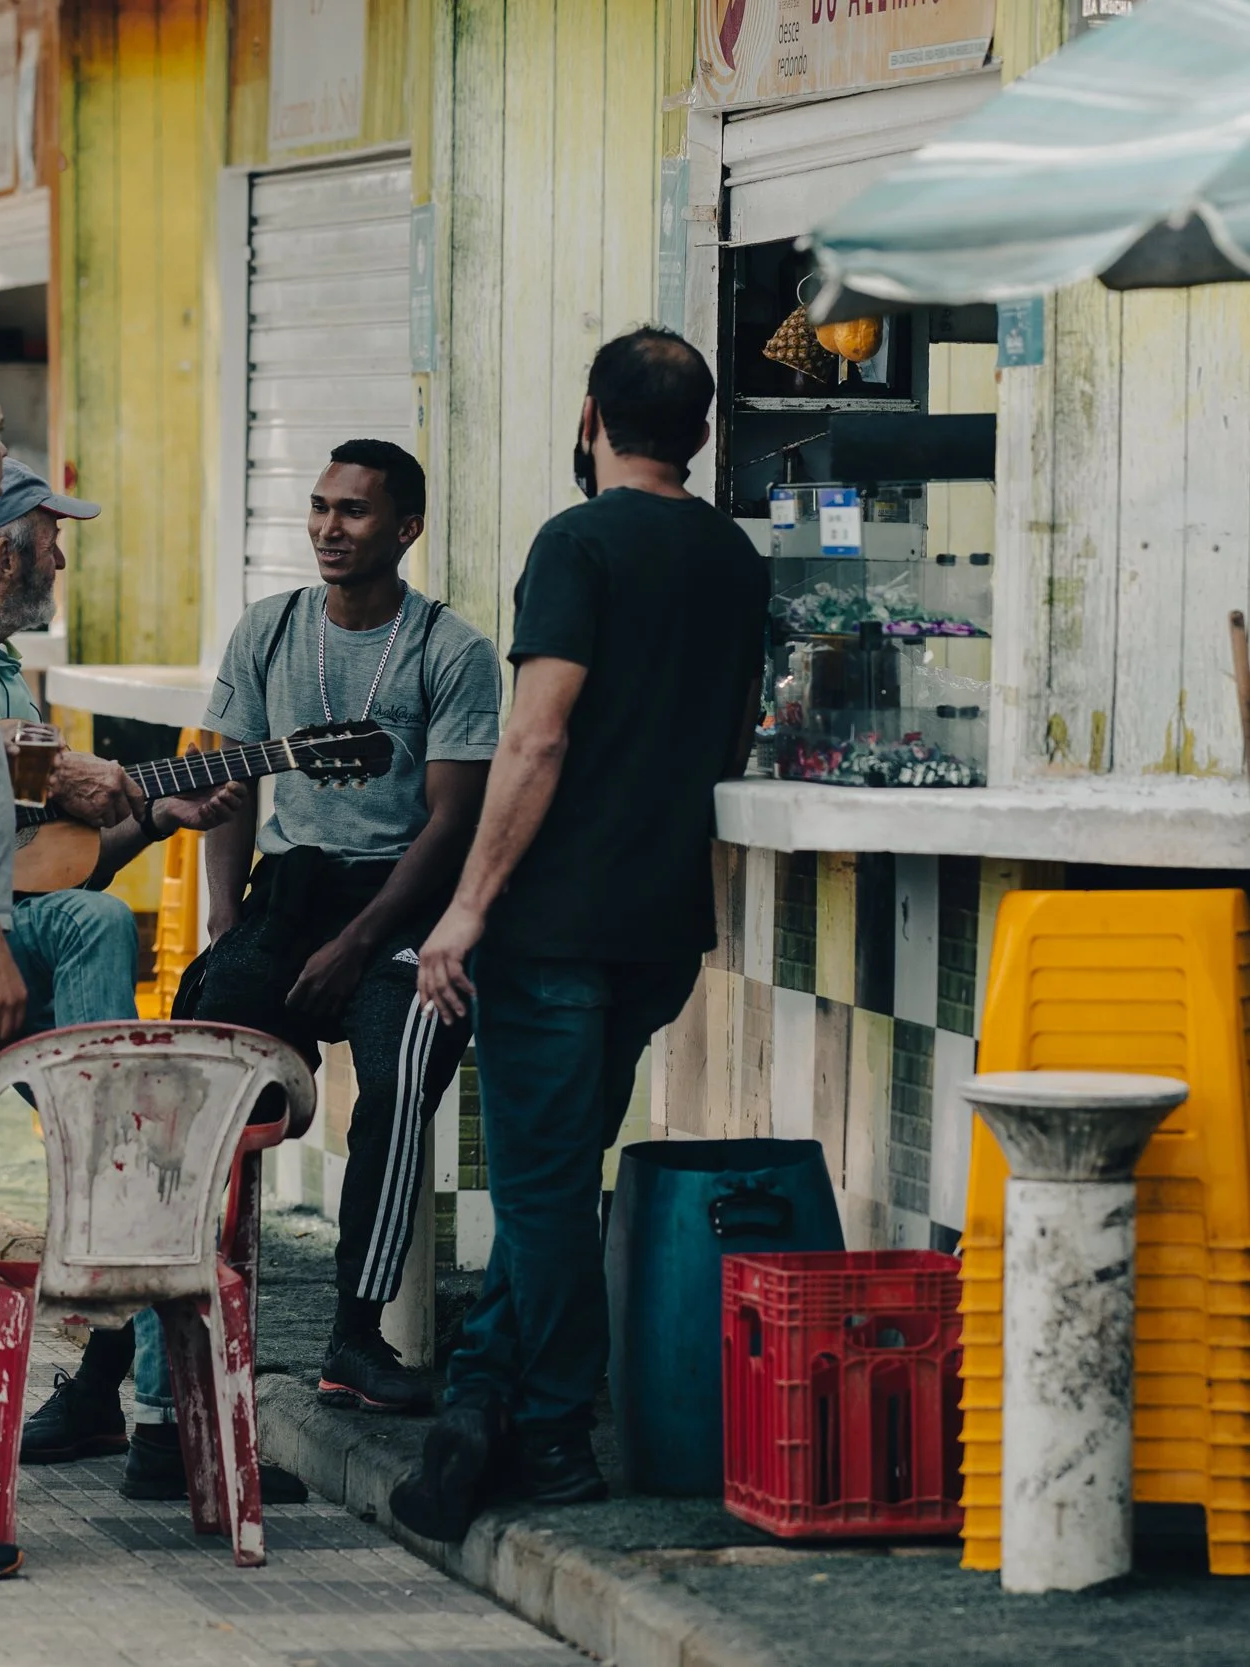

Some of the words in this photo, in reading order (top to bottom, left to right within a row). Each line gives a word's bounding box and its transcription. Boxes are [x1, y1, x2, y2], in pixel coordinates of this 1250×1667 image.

[778, 15, 800, 44] desce
[777, 46, 808, 77] redondo
[392, 954, 420, 966] adida
